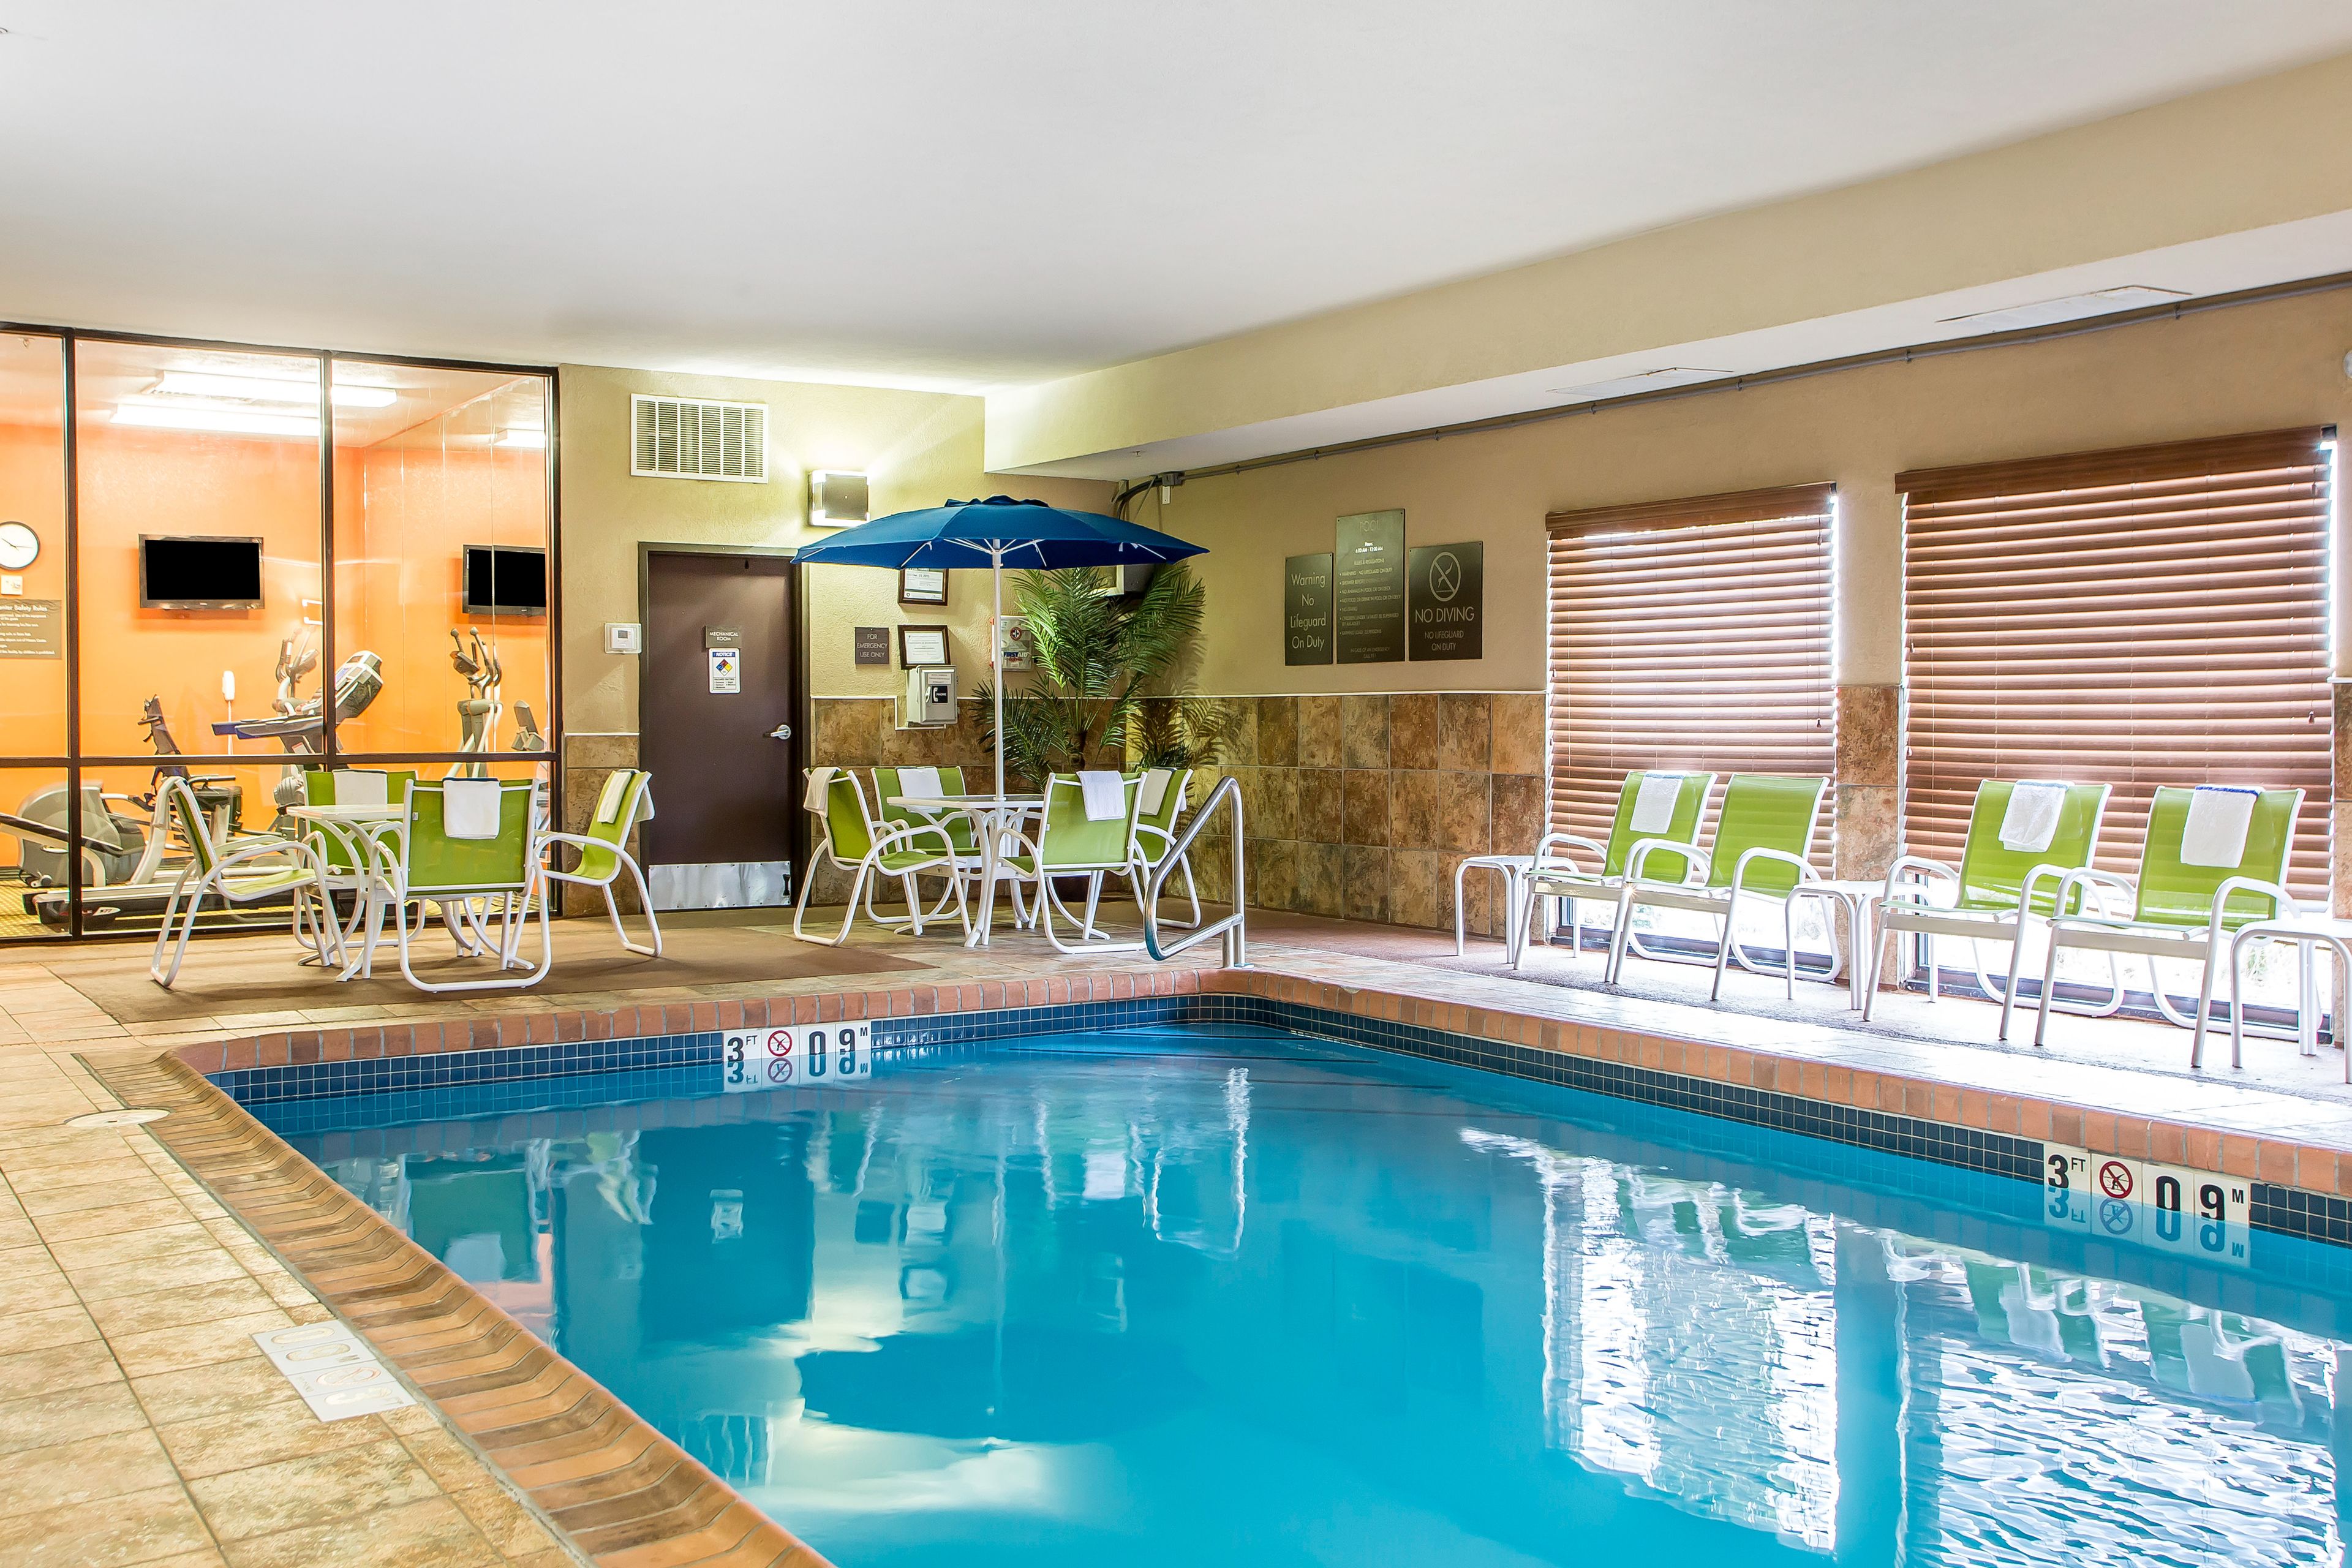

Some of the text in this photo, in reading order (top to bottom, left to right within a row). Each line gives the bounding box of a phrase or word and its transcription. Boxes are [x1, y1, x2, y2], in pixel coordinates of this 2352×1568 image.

[1291, 572, 1325, 588] Warning
[1302, 594, 1314, 606] No
[1290, 611, 1326, 631] Lifeguard
[1415, 606, 1474, 623] NO DIVING
[1435, 630, 1464, 639] LIFEGUARD
[1292, 635, 1325, 652] On Duty
[727, 1037, 744, 1061] 3
[746, 1035, 758, 1046] FT
[860, 1027, 868, 1036] M
[2048, 1154, 2070, 1189] 3
[2071, 1157, 2086, 1172] FT
[2232, 1188, 2244, 1204] M
